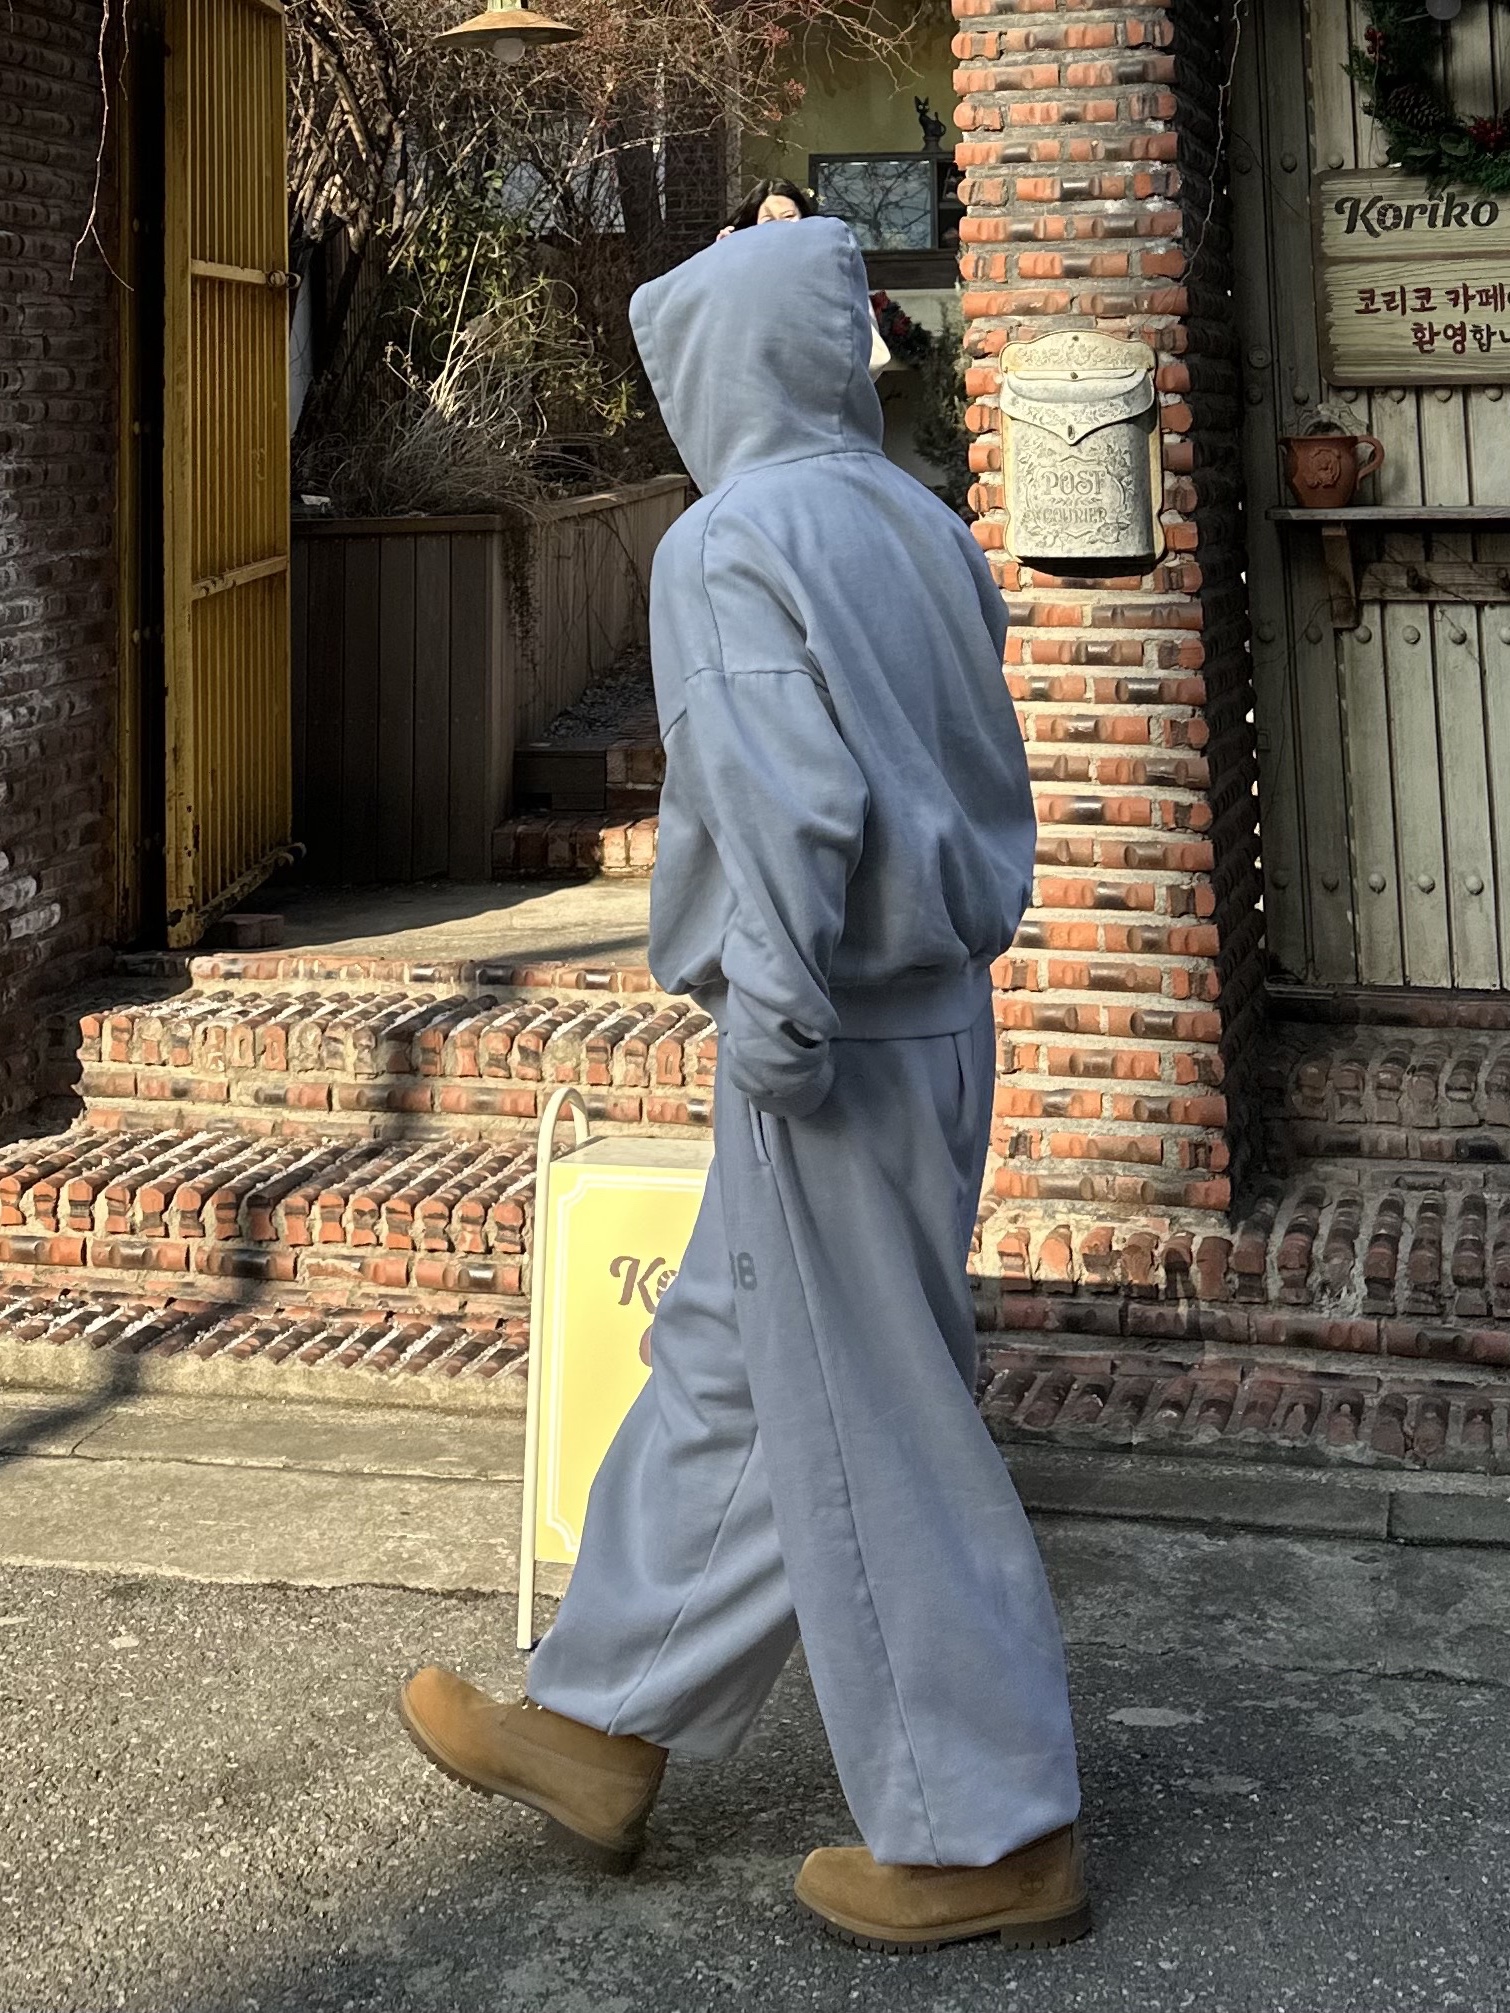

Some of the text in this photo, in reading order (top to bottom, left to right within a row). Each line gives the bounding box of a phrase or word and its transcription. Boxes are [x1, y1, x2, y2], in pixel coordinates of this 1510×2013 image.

[1334, 191, 1499, 239] Koriko
[1355, 282, 1510, 316] 코리코 카페
[1041, 469, 1106, 496] POST
